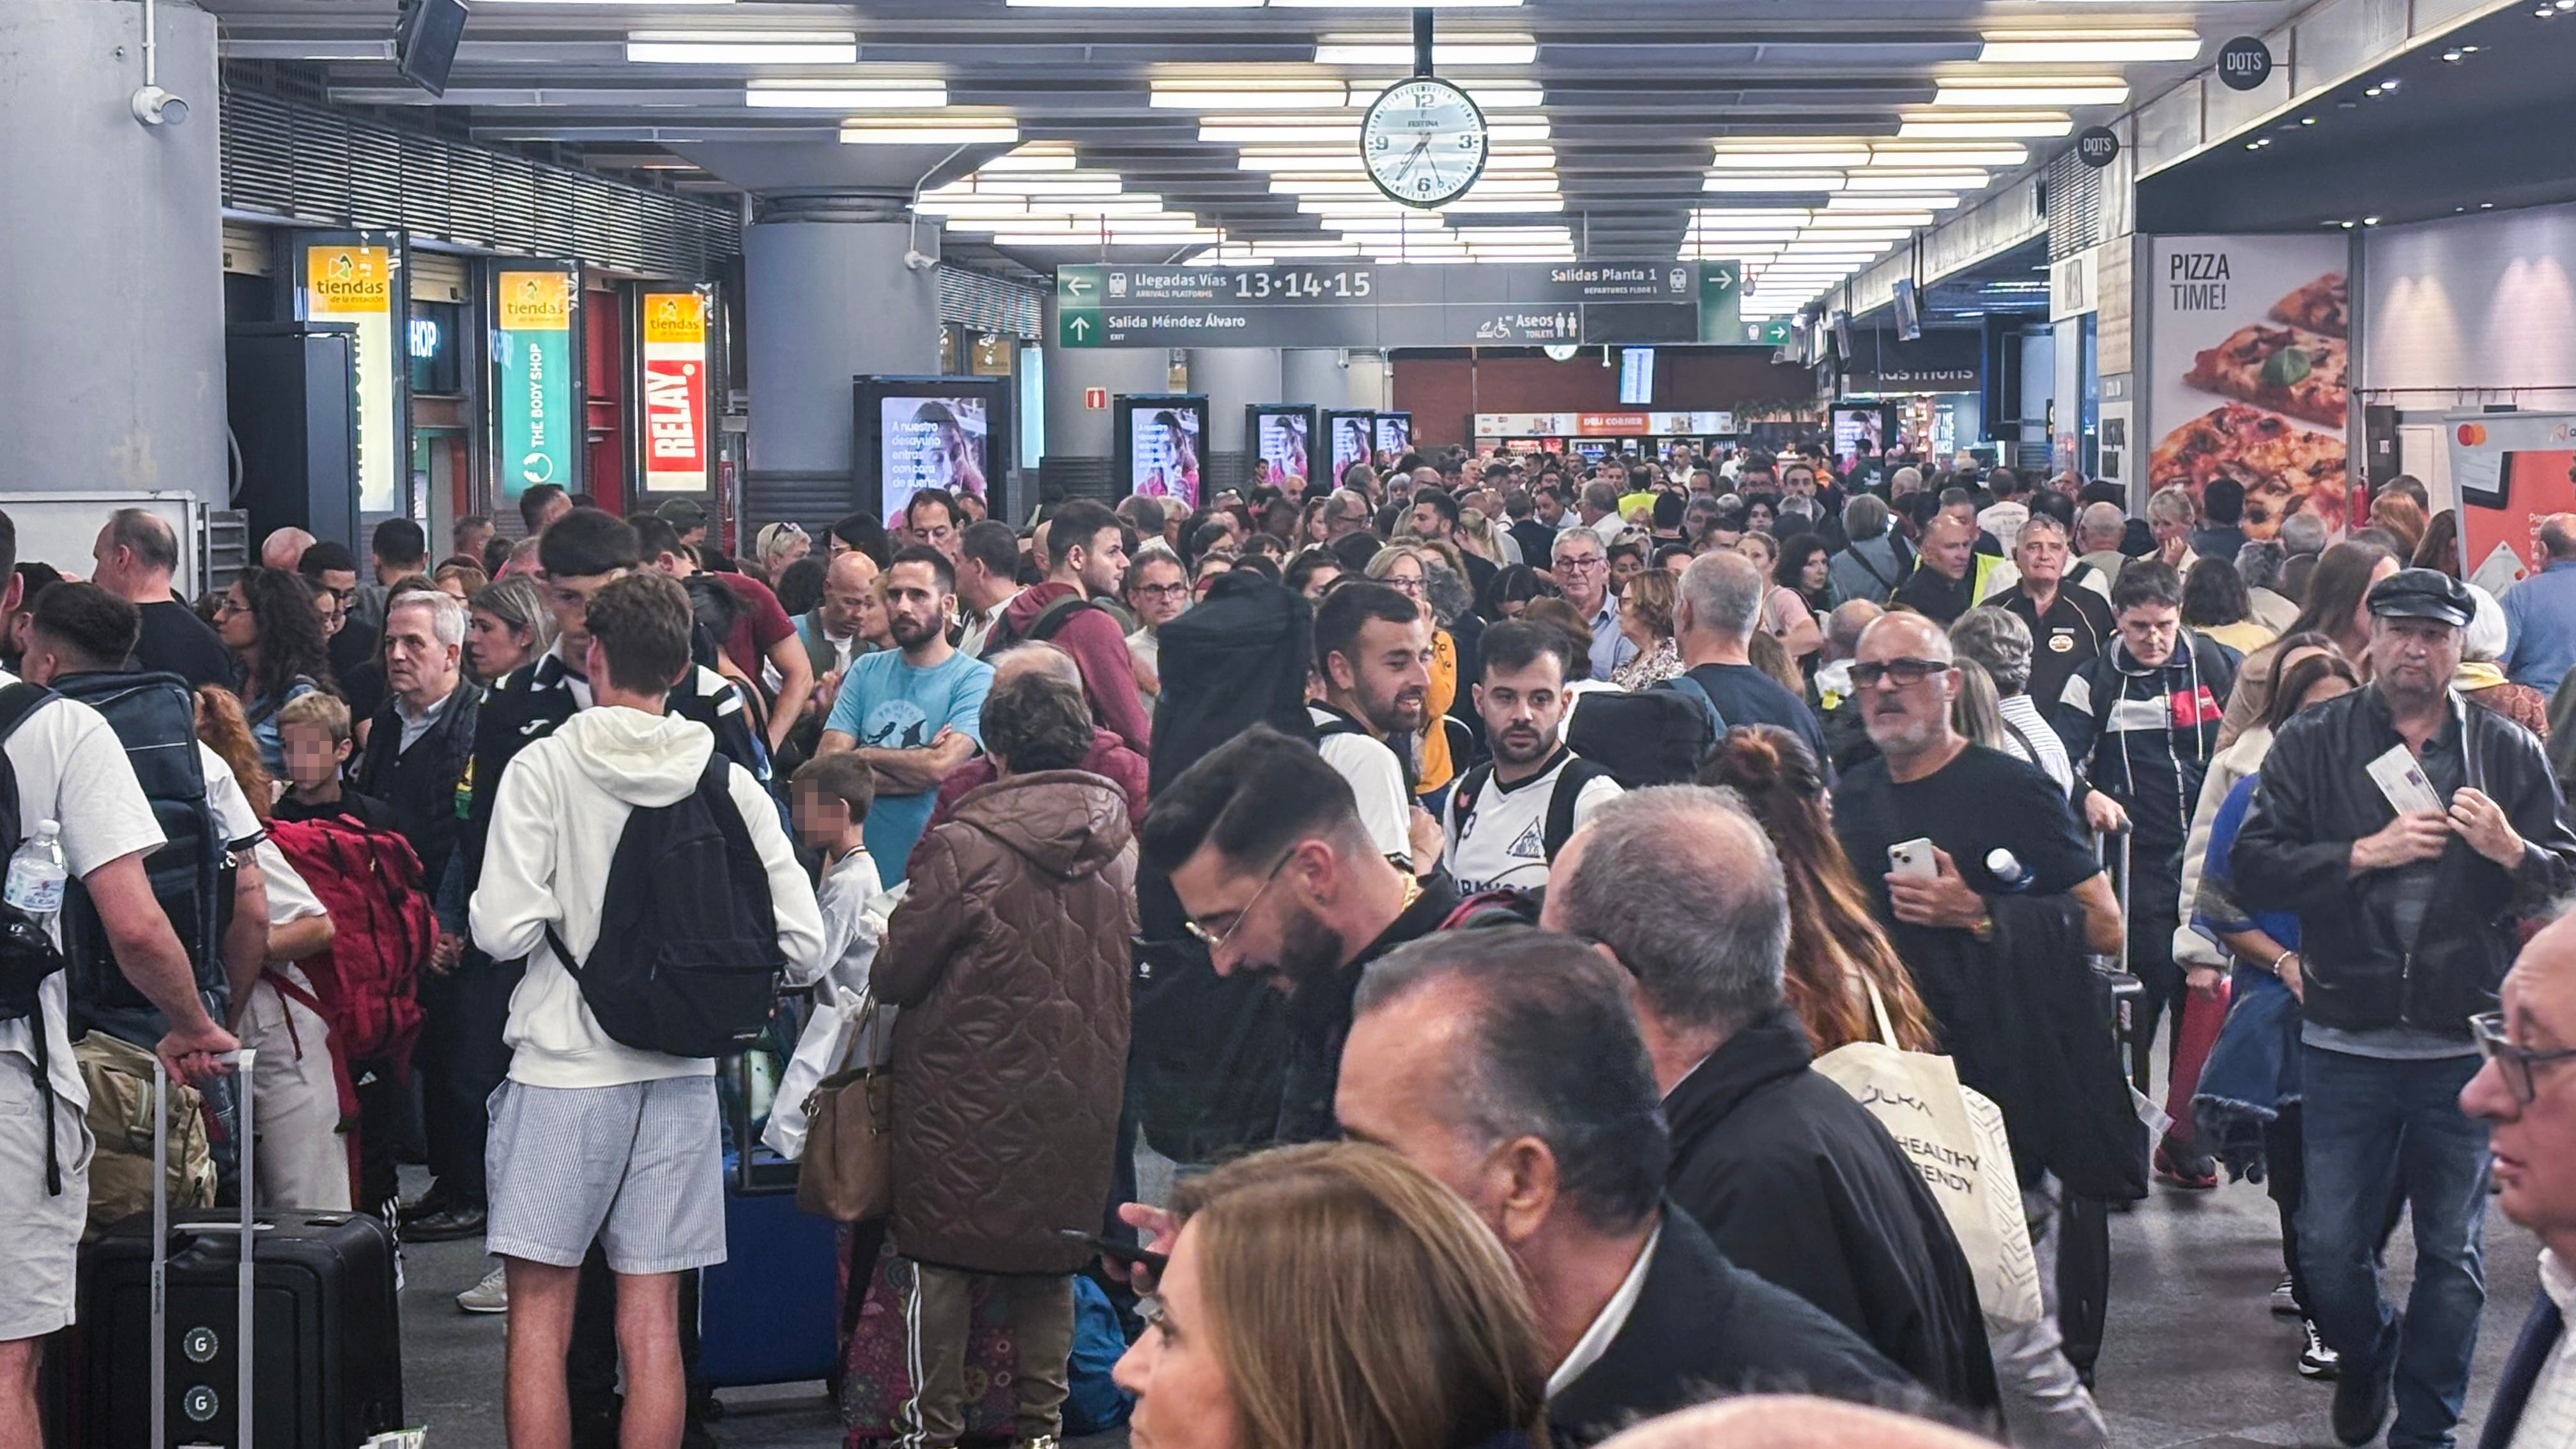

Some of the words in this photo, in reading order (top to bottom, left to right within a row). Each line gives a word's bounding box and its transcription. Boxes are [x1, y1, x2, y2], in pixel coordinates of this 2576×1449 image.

[2227, 52, 2262, 71] DOTS
[1413, 93, 1435, 109] 12
[1407, 119, 1439, 128] FESTINA
[1374, 135, 1389, 150] 9
[1458, 134, 1472, 149] 3
[2083, 137, 2112, 153] DOTS
[1417, 178, 1430, 192] 6
[1551, 268, 1598, 282] Salidas
[1602, 267, 1644, 282] Planta
[1649, 268, 1657, 281] 1
[2170, 253, 2230, 281] PIZZA
[317, 279, 384, 295] tiendas
[1135, 273, 1195, 289] Llegadas
[1199, 273, 1227, 287] Vías
[1135, 290, 1170, 298] ARRIVALS
[1171, 289, 1213, 298] PLATFORMS
[1584, 286, 1629, 295] DEPARTURES
[1629, 286, 1652, 295] FLOOR
[2170, 284, 2227, 311] TIME!
[330, 295, 341, 303] de
[342, 295, 349, 303] la
[507, 302, 564, 316] tiendas
[650, 318, 700, 331] tiendas
[1108, 315, 1148, 329] Salida
[1152, 313, 1202, 328] Méndez
[1205, 312, 1246, 328] Álvaro
[1515, 313, 1554, 328] Aseos
[1110, 333, 1125, 342] EXIT
[1524, 330, 1554, 339] TOILETS
[529, 342, 544, 381] SHOP
[530, 383, 544, 418] BODY
[892, 422, 900, 432] A
[901, 422, 939, 433] nuestro
[1584, 417, 1603, 426] DELI
[1606, 417, 1643, 426] CORNER
[532, 420, 545, 448] THE
[892, 436, 942, 450] desayuno
[892, 478, 905, 488] de
[1895, 1135, 1980, 1172] HEALTHY
[194, 1337, 208, 1353] G
[194, 1396, 208, 1412] G
